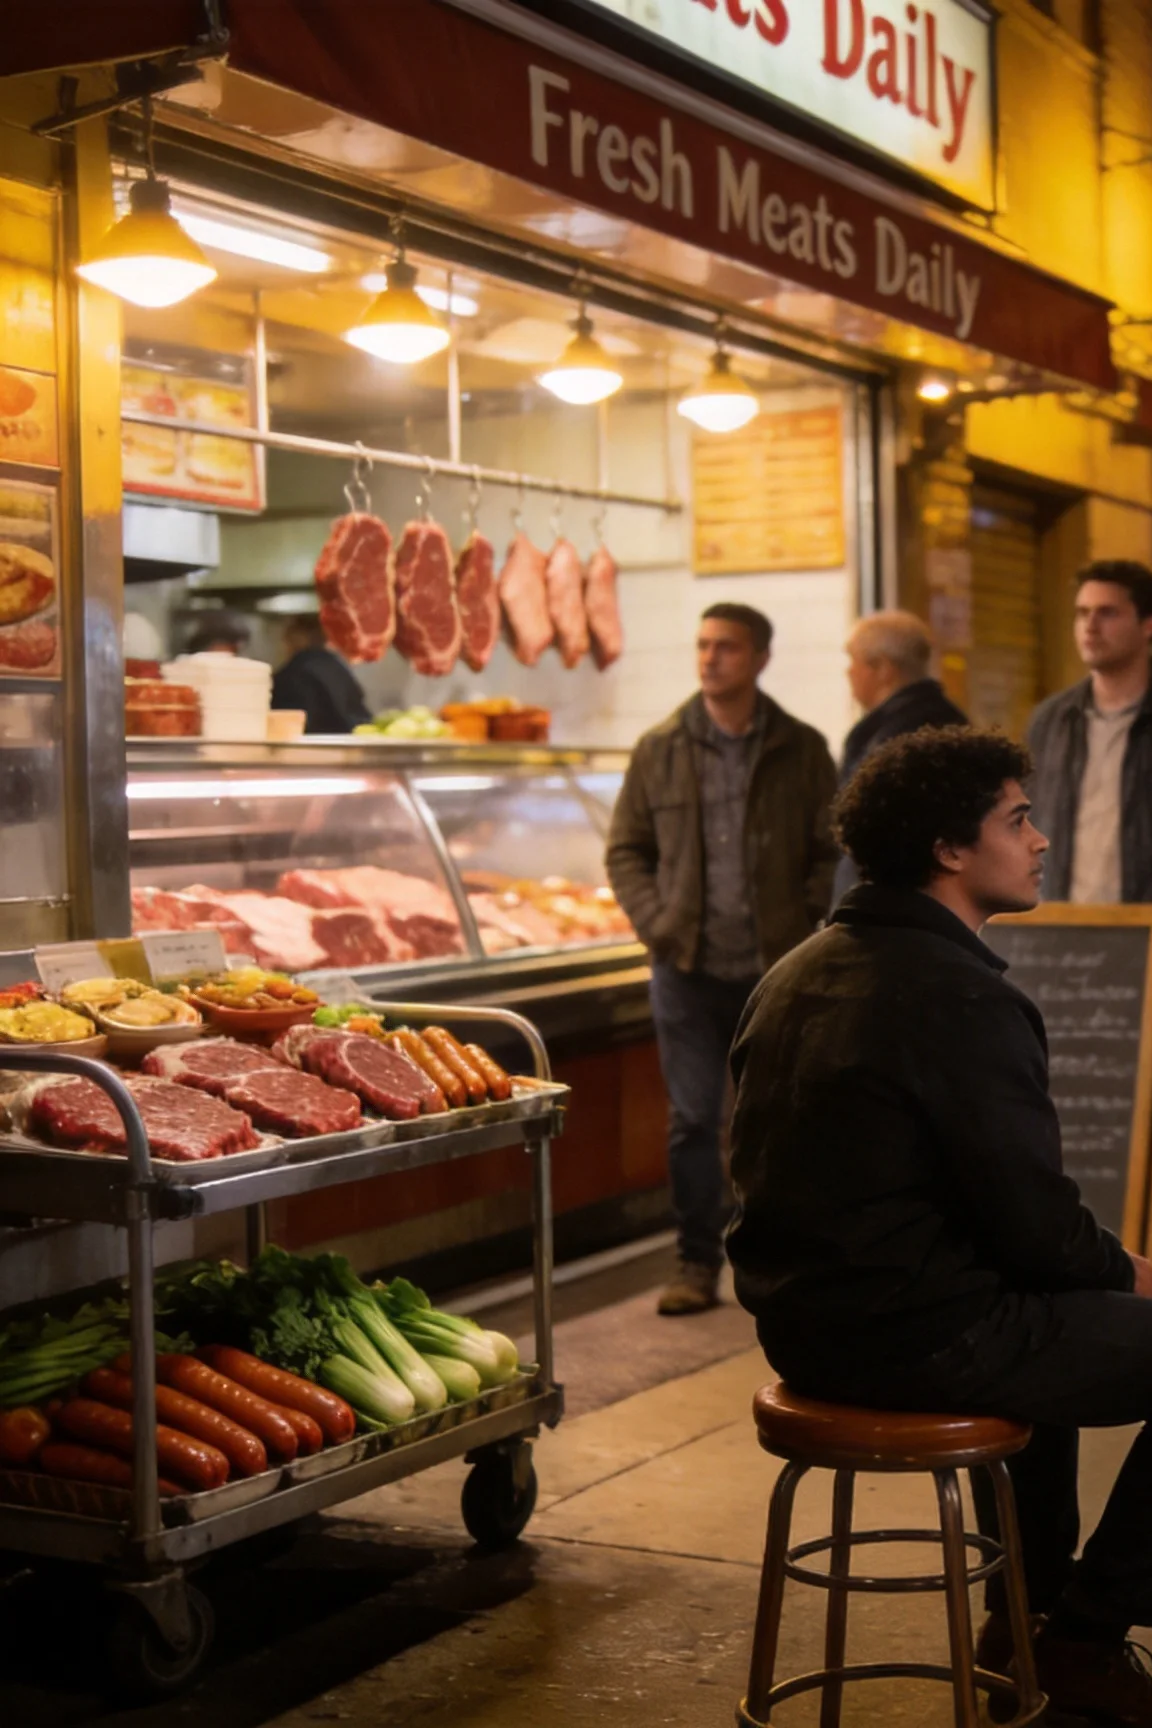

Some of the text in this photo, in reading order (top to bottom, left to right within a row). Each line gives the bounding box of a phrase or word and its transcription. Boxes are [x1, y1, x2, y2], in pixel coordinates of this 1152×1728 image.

[821, 0, 976, 163] Daily
[529, 65, 981, 338] Fresh Meats Daily
